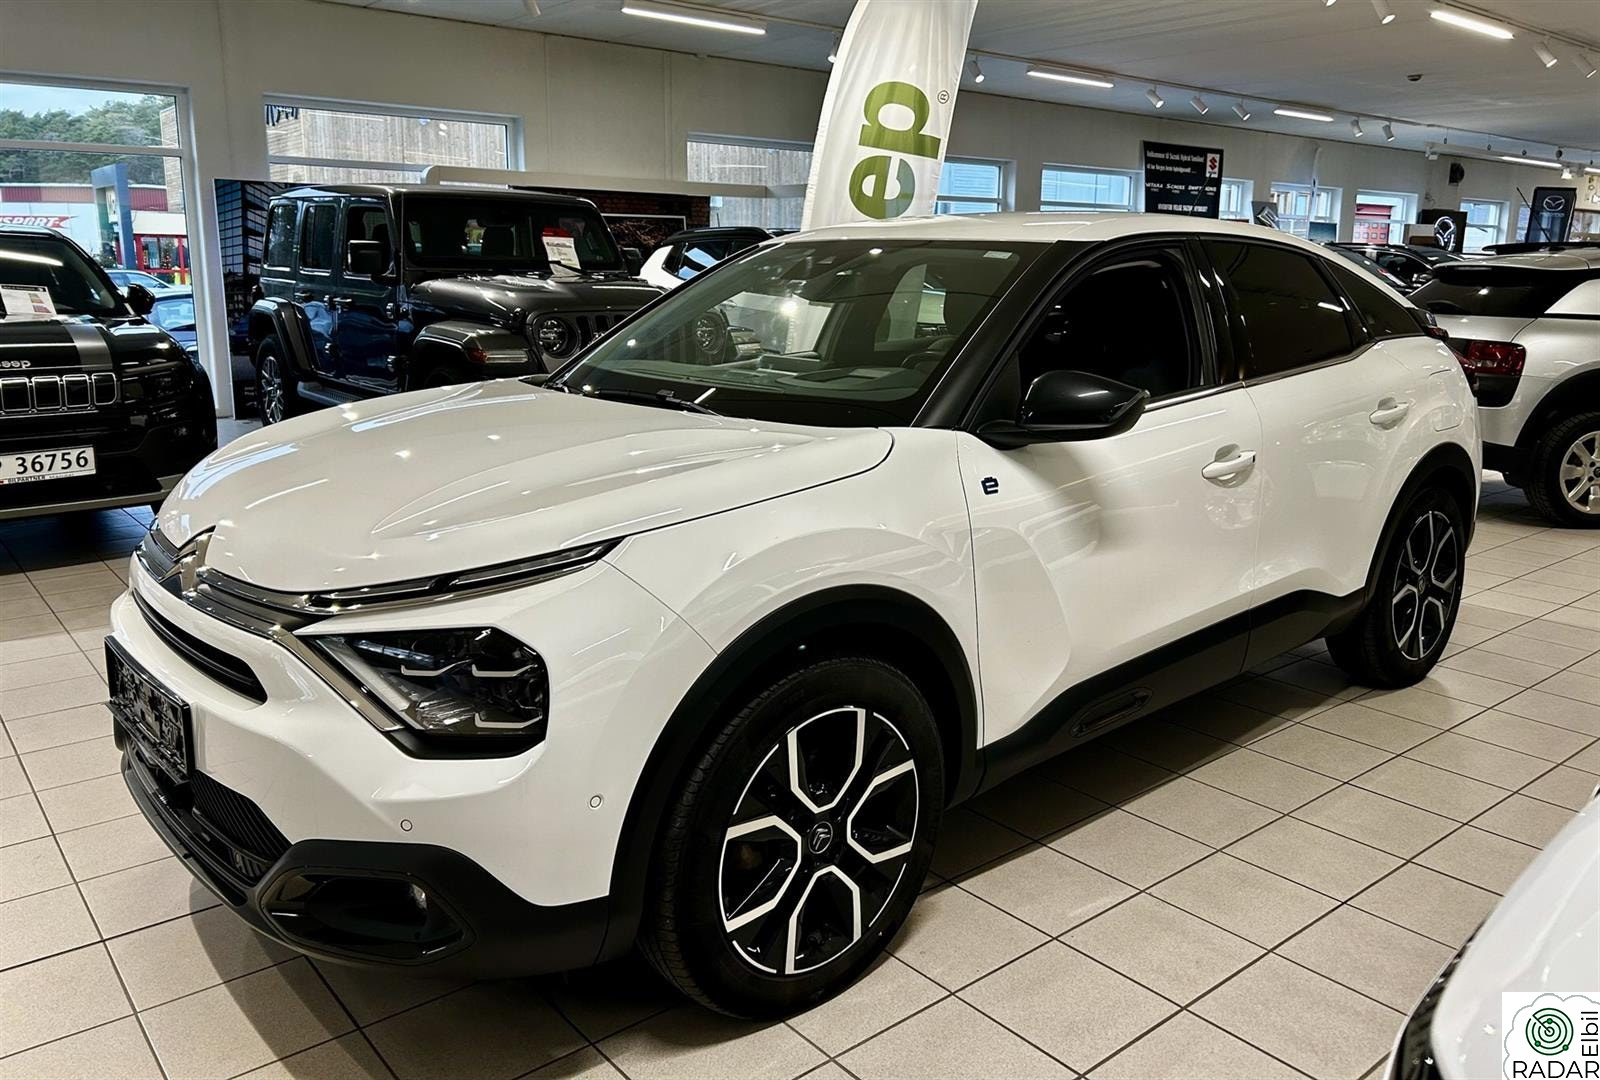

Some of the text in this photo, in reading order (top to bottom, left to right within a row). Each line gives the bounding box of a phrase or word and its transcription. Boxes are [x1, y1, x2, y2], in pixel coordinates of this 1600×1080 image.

[849, 81, 941, 219] ep
[0, 216, 58, 227] SPORT
[0, 360, 31, 369] eep
[15, 450, 88, 475] 36756
